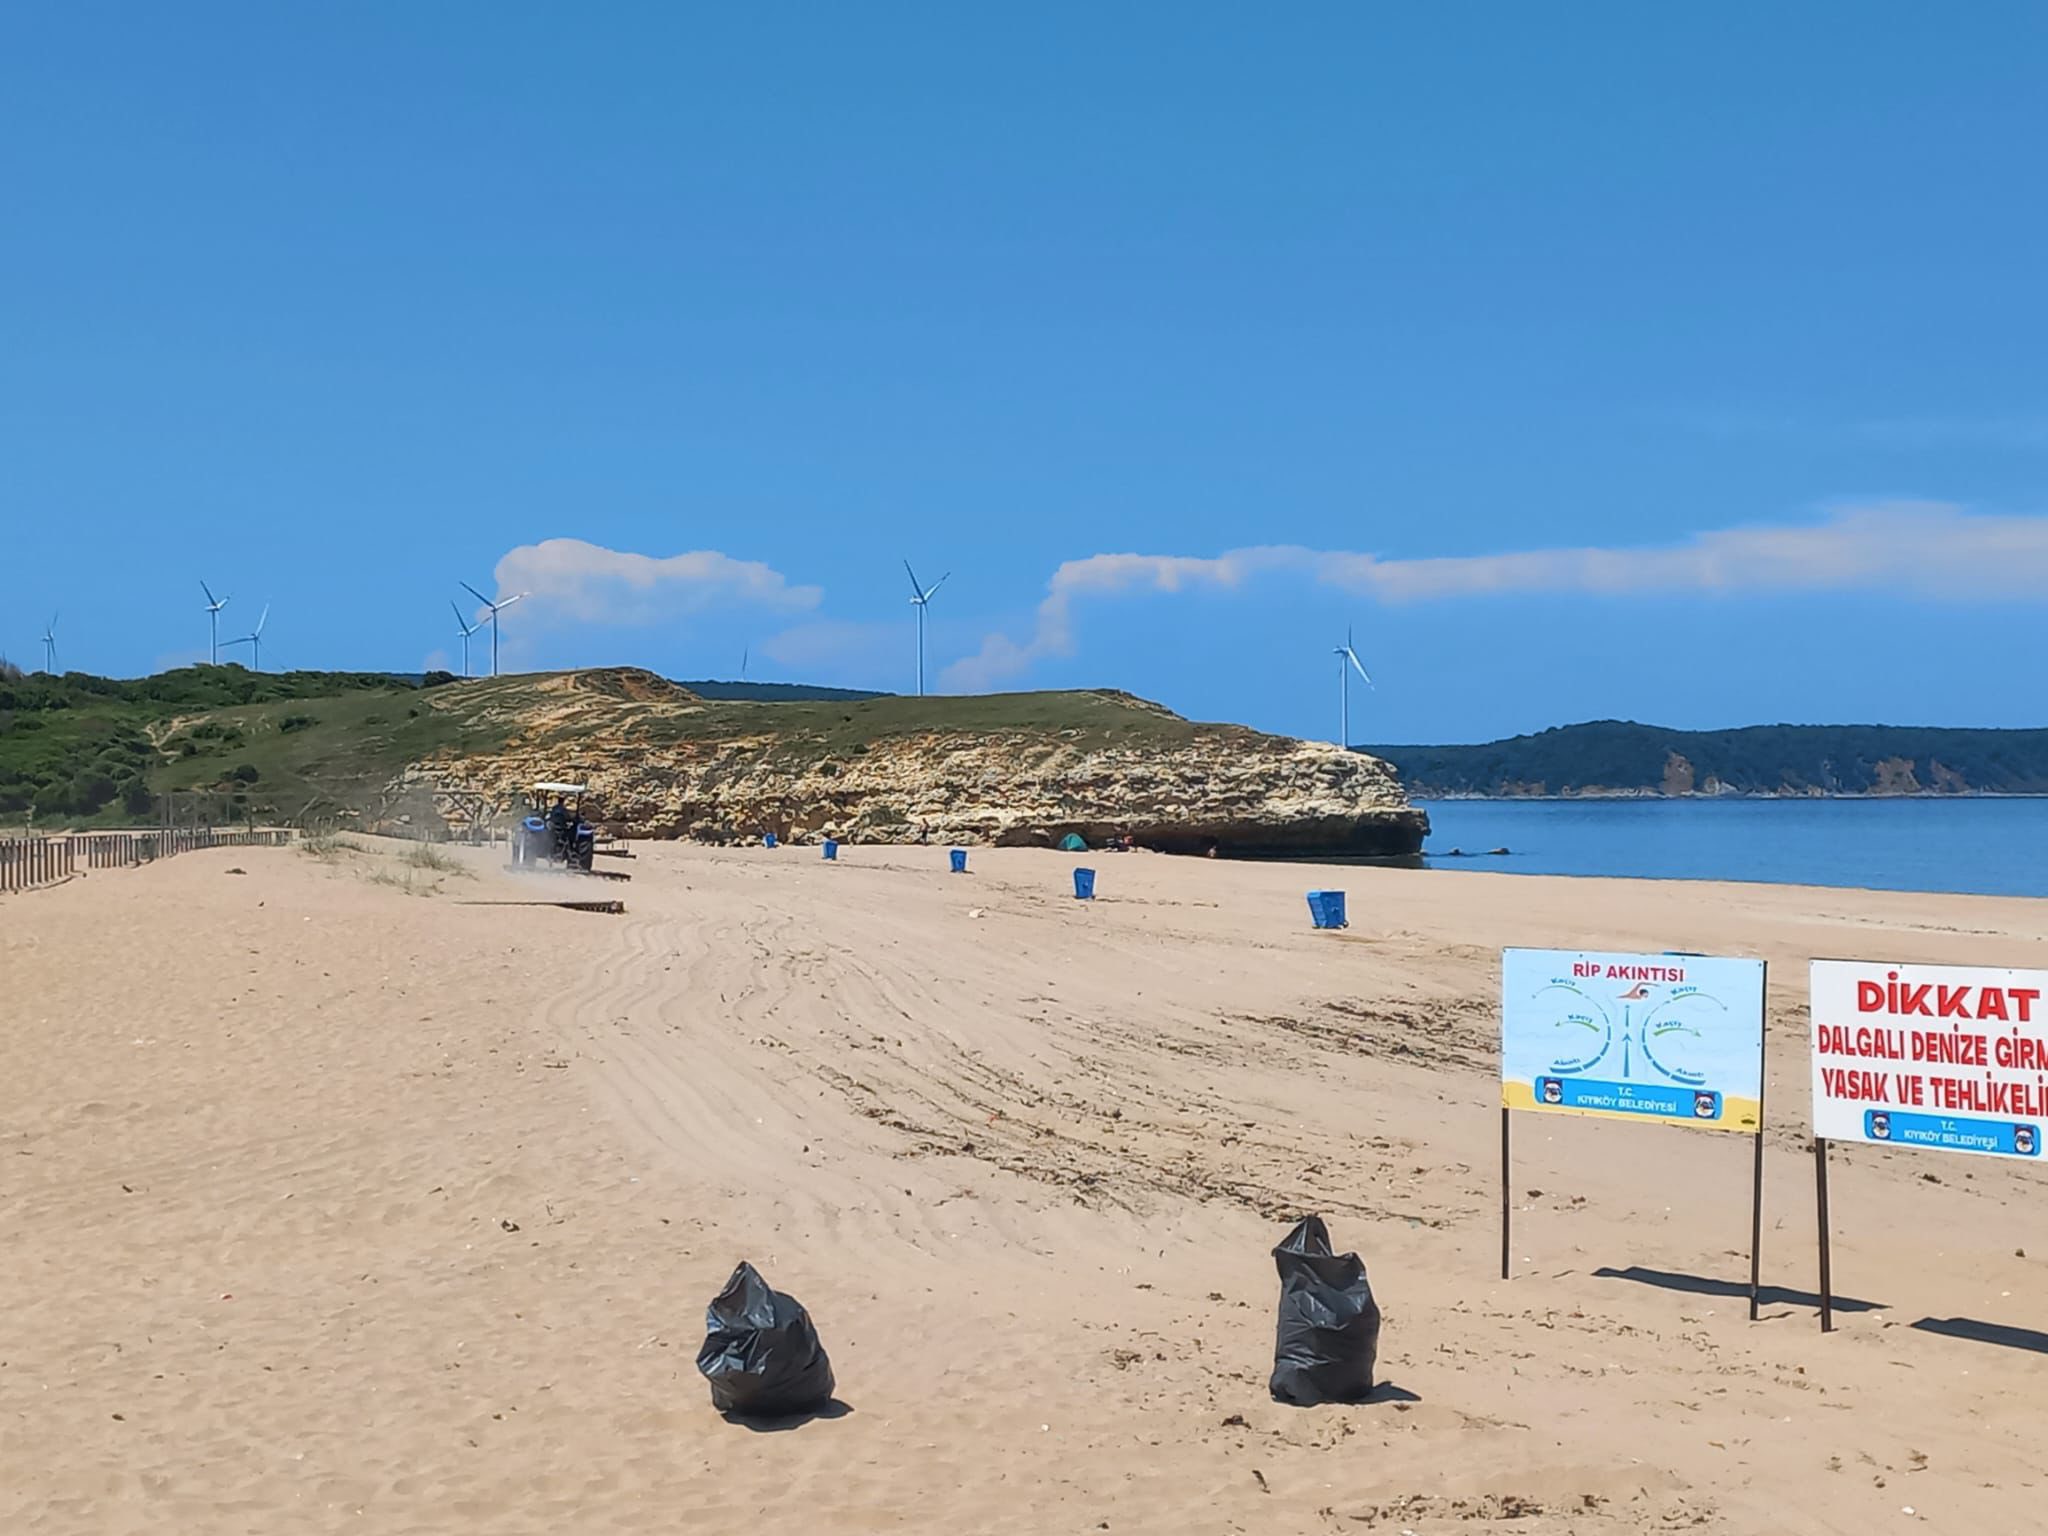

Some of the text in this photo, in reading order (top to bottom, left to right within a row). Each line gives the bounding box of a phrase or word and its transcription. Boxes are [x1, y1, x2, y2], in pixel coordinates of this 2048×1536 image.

[1573, 960, 1684, 982] RİP AKINTISI
[1857, 971, 2041, 1022] DİKKAT
[1818, 1024, 1905, 1060] DALGALI
[1911, 1023, 1988, 1067] DENİZE
[1618, 1098, 1677, 1113] BELEDİYESİ
[1821, 1067, 2048, 1118] YASAK VE TEHLİKELİ
